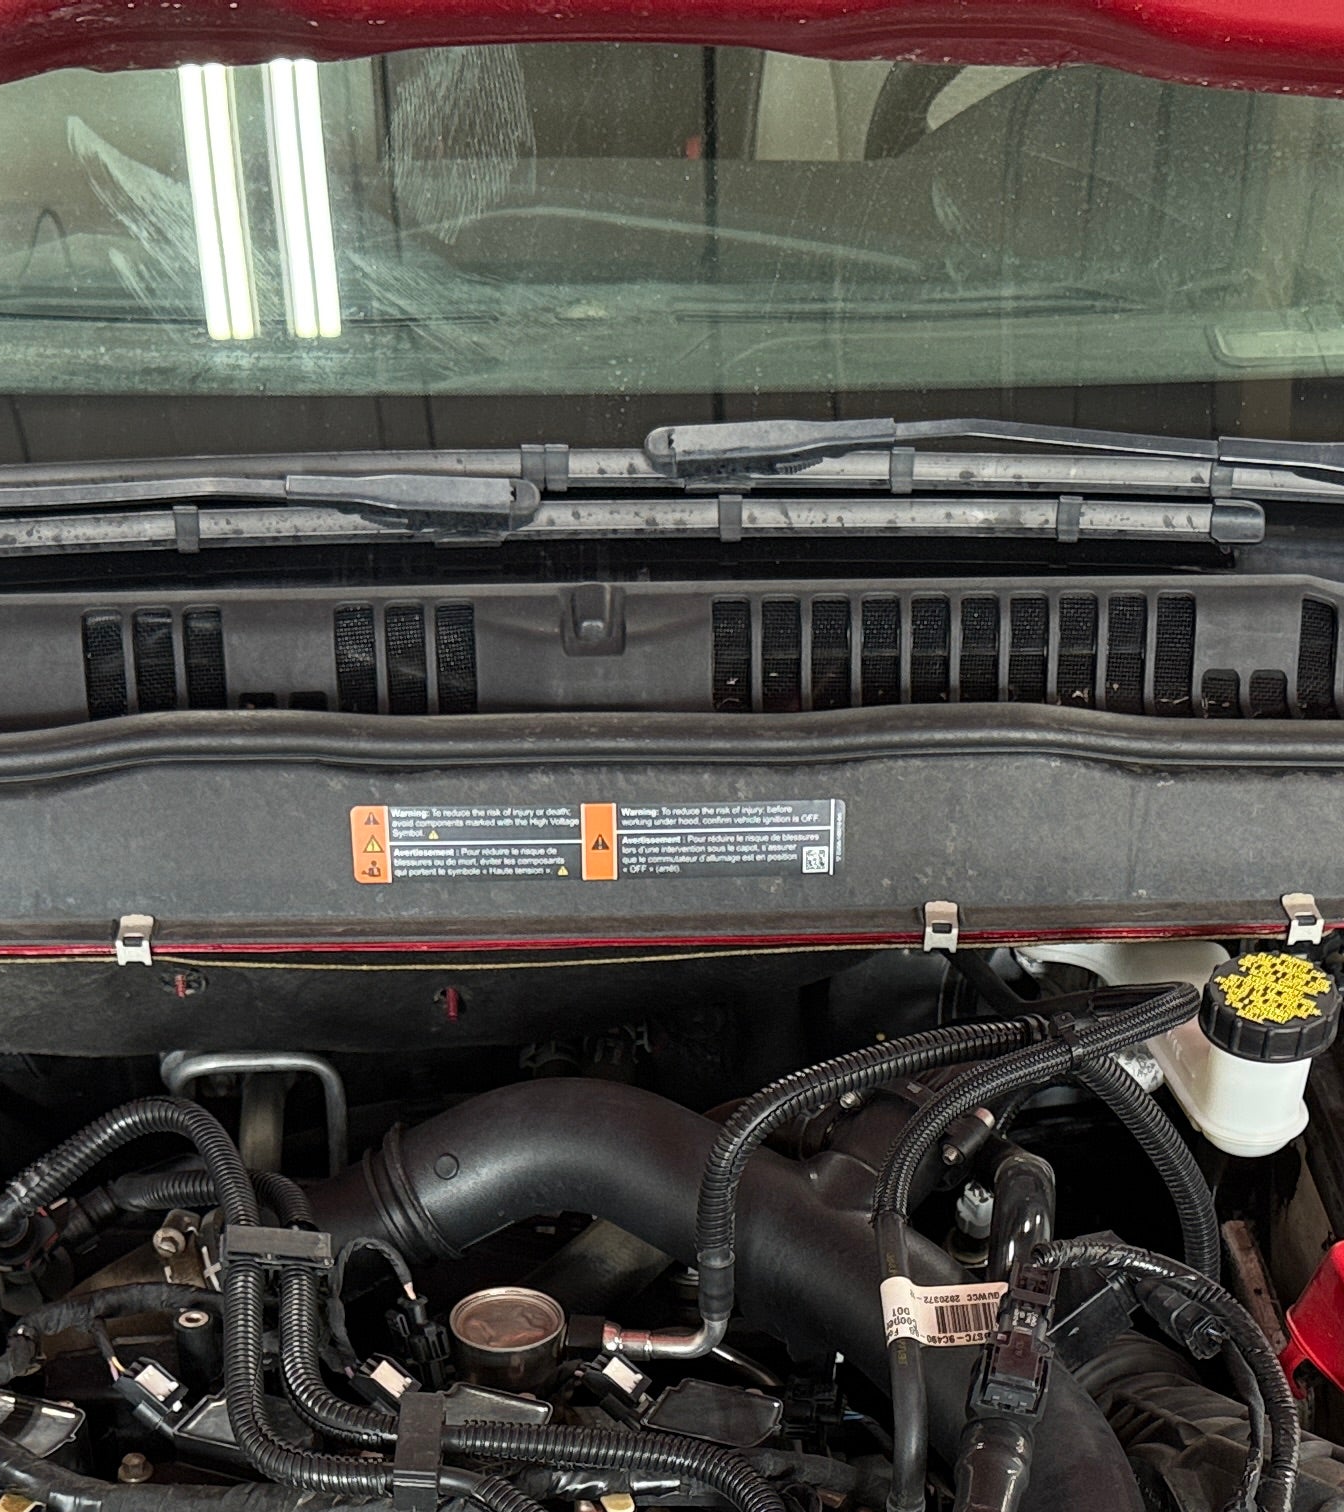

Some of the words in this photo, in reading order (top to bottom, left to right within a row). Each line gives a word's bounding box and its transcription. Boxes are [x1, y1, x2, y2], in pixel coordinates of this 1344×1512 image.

[432, 808, 442, 817] To
[442, 808, 470, 817] reduce
[472, 808, 485, 816] the
[487, 808, 501, 816] risk
[502, 808, 511, 816] of
[512, 808, 534, 818] injury
[662, 807, 671, 815] To
[672, 807, 700, 815] reduce
[702, 807, 714, 815] the
[716, 806, 730, 814] risk
[732, 806, 740, 814] of
[766, 805, 792, 814] before
[415, 820, 464, 828] components
[466, 818, 495, 827] marked
[496, 818, 513, 826] with
[514, 818, 528, 826] the
[530, 818, 548, 828] High
[550, 818, 579, 827] Voltage
[622, 818, 652, 827] working
[654, 818, 677, 826] under
[734, 816, 761, 824] vehicle
[763, 816, 791, 825] ignition
[745, 835, 769, 843] risque
[461, 848, 480, 856] Pour
[520, 848, 545, 856] risque
[546, 847, 557, 855] de
[622, 846, 637, 854] lors
[661, 845, 705, 853] intervention
[517, 858, 565, 866] composants
[767, 854, 797, 862] position
[394, 869, 407, 877] qui
[447, 868, 480, 877] symbole
